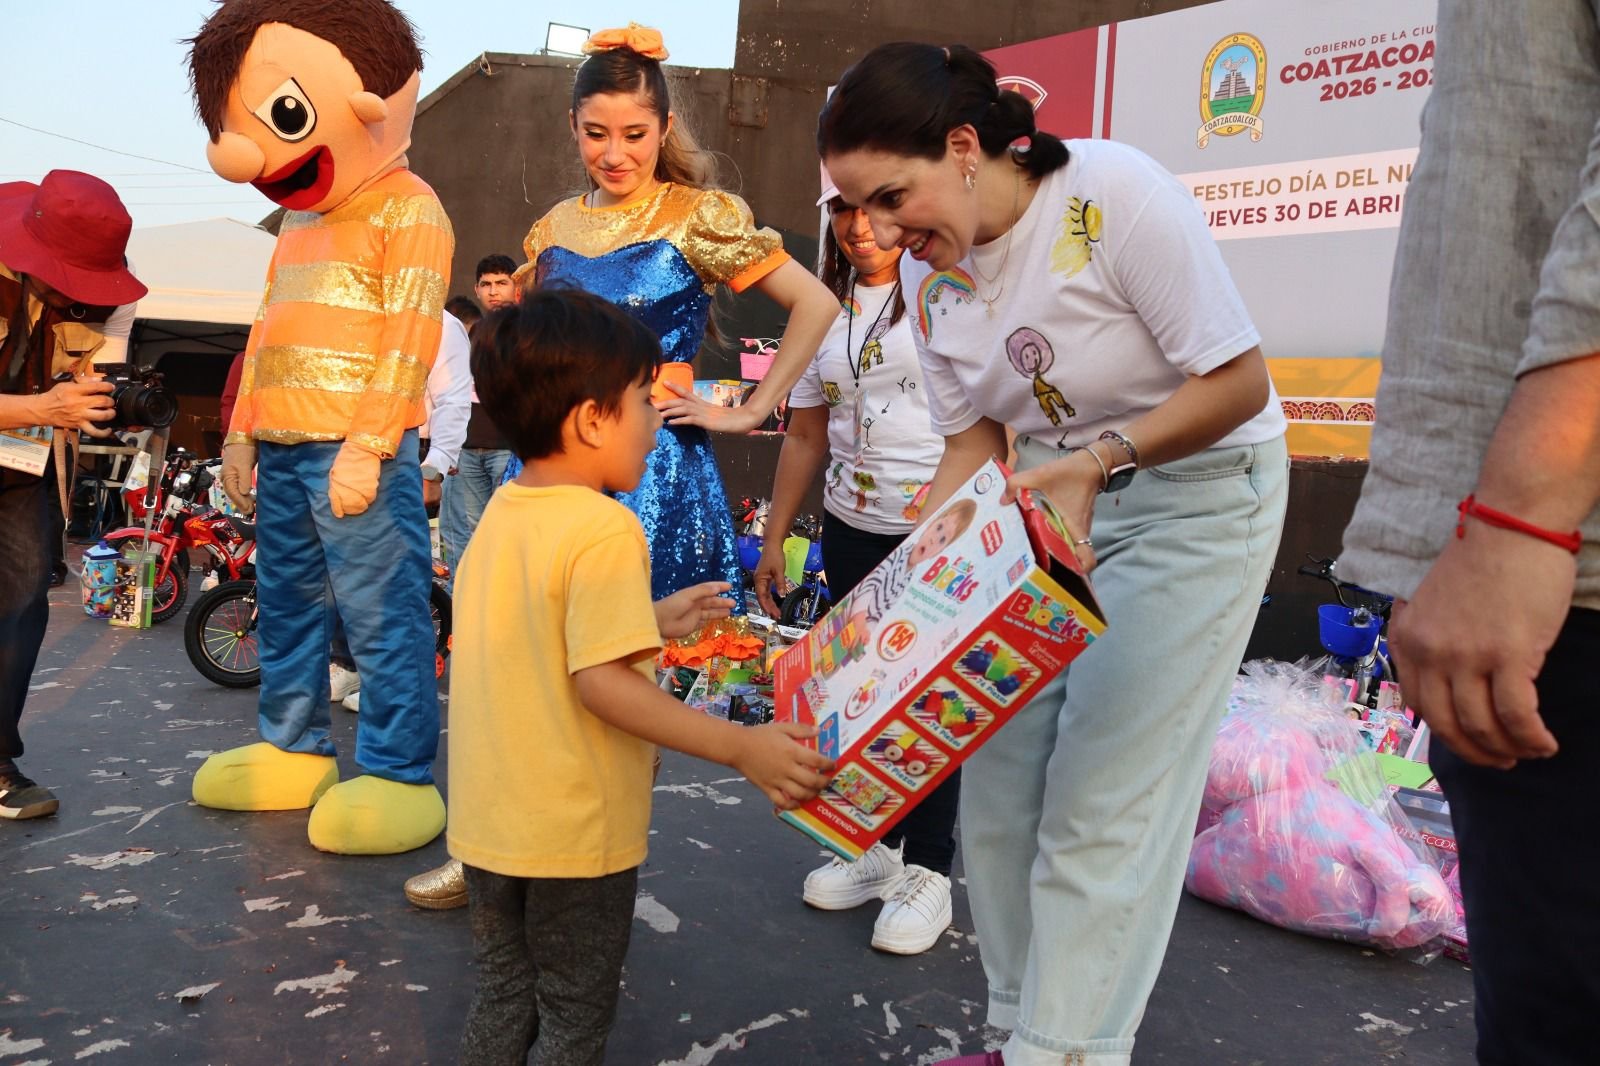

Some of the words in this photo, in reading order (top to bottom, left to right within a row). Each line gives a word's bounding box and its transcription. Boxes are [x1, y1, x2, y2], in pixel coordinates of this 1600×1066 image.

[1305, 38, 1366, 56] GOBIERNO
[1371, 33, 1387, 45] DE
[1392, 30, 1407, 41] LA
[1412, 24, 1436, 37] CIU
[1279, 40, 1436, 84] COATZACOA
[1319, 76, 1377, 102] 2026
[1204, 115, 1257, 132] COATZACOALCOS
[1193, 178, 1282, 201] FESTEJO
[1289, 170, 1327, 193] DÍA
[1335, 168, 1379, 189] DEL
[1274, 203, 1300, 222] 30
[1308, 200, 1338, 220] DE
[1344, 194, 1400, 217] ABRI
[887, 625, 915, 653] 150
[816, 804, 858, 836] CONTENIDO
